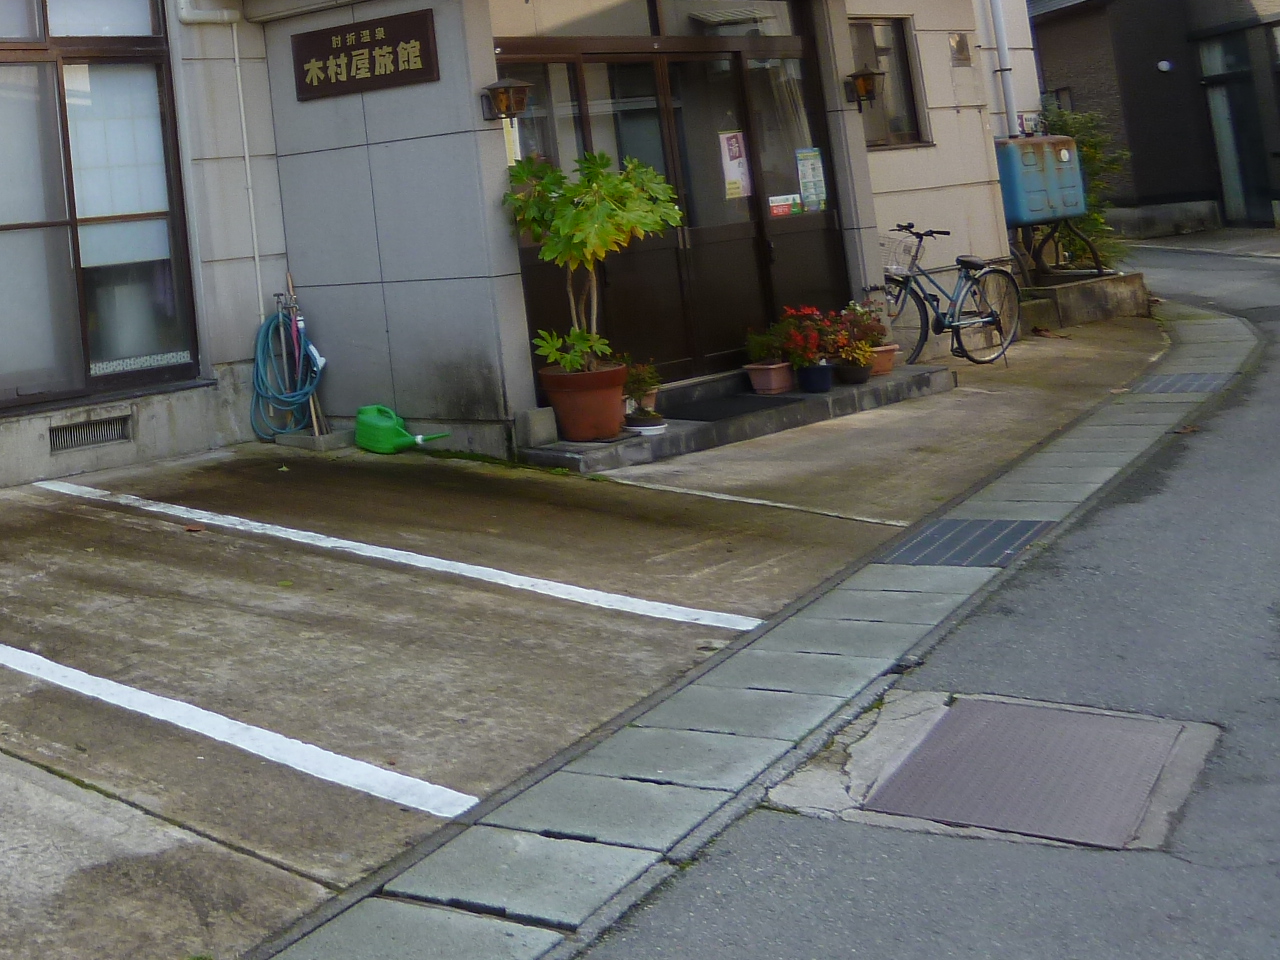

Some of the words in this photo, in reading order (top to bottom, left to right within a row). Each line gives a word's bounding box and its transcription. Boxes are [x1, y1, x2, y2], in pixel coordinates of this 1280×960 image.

[303, 39, 423, 86] 木村屋旅館
